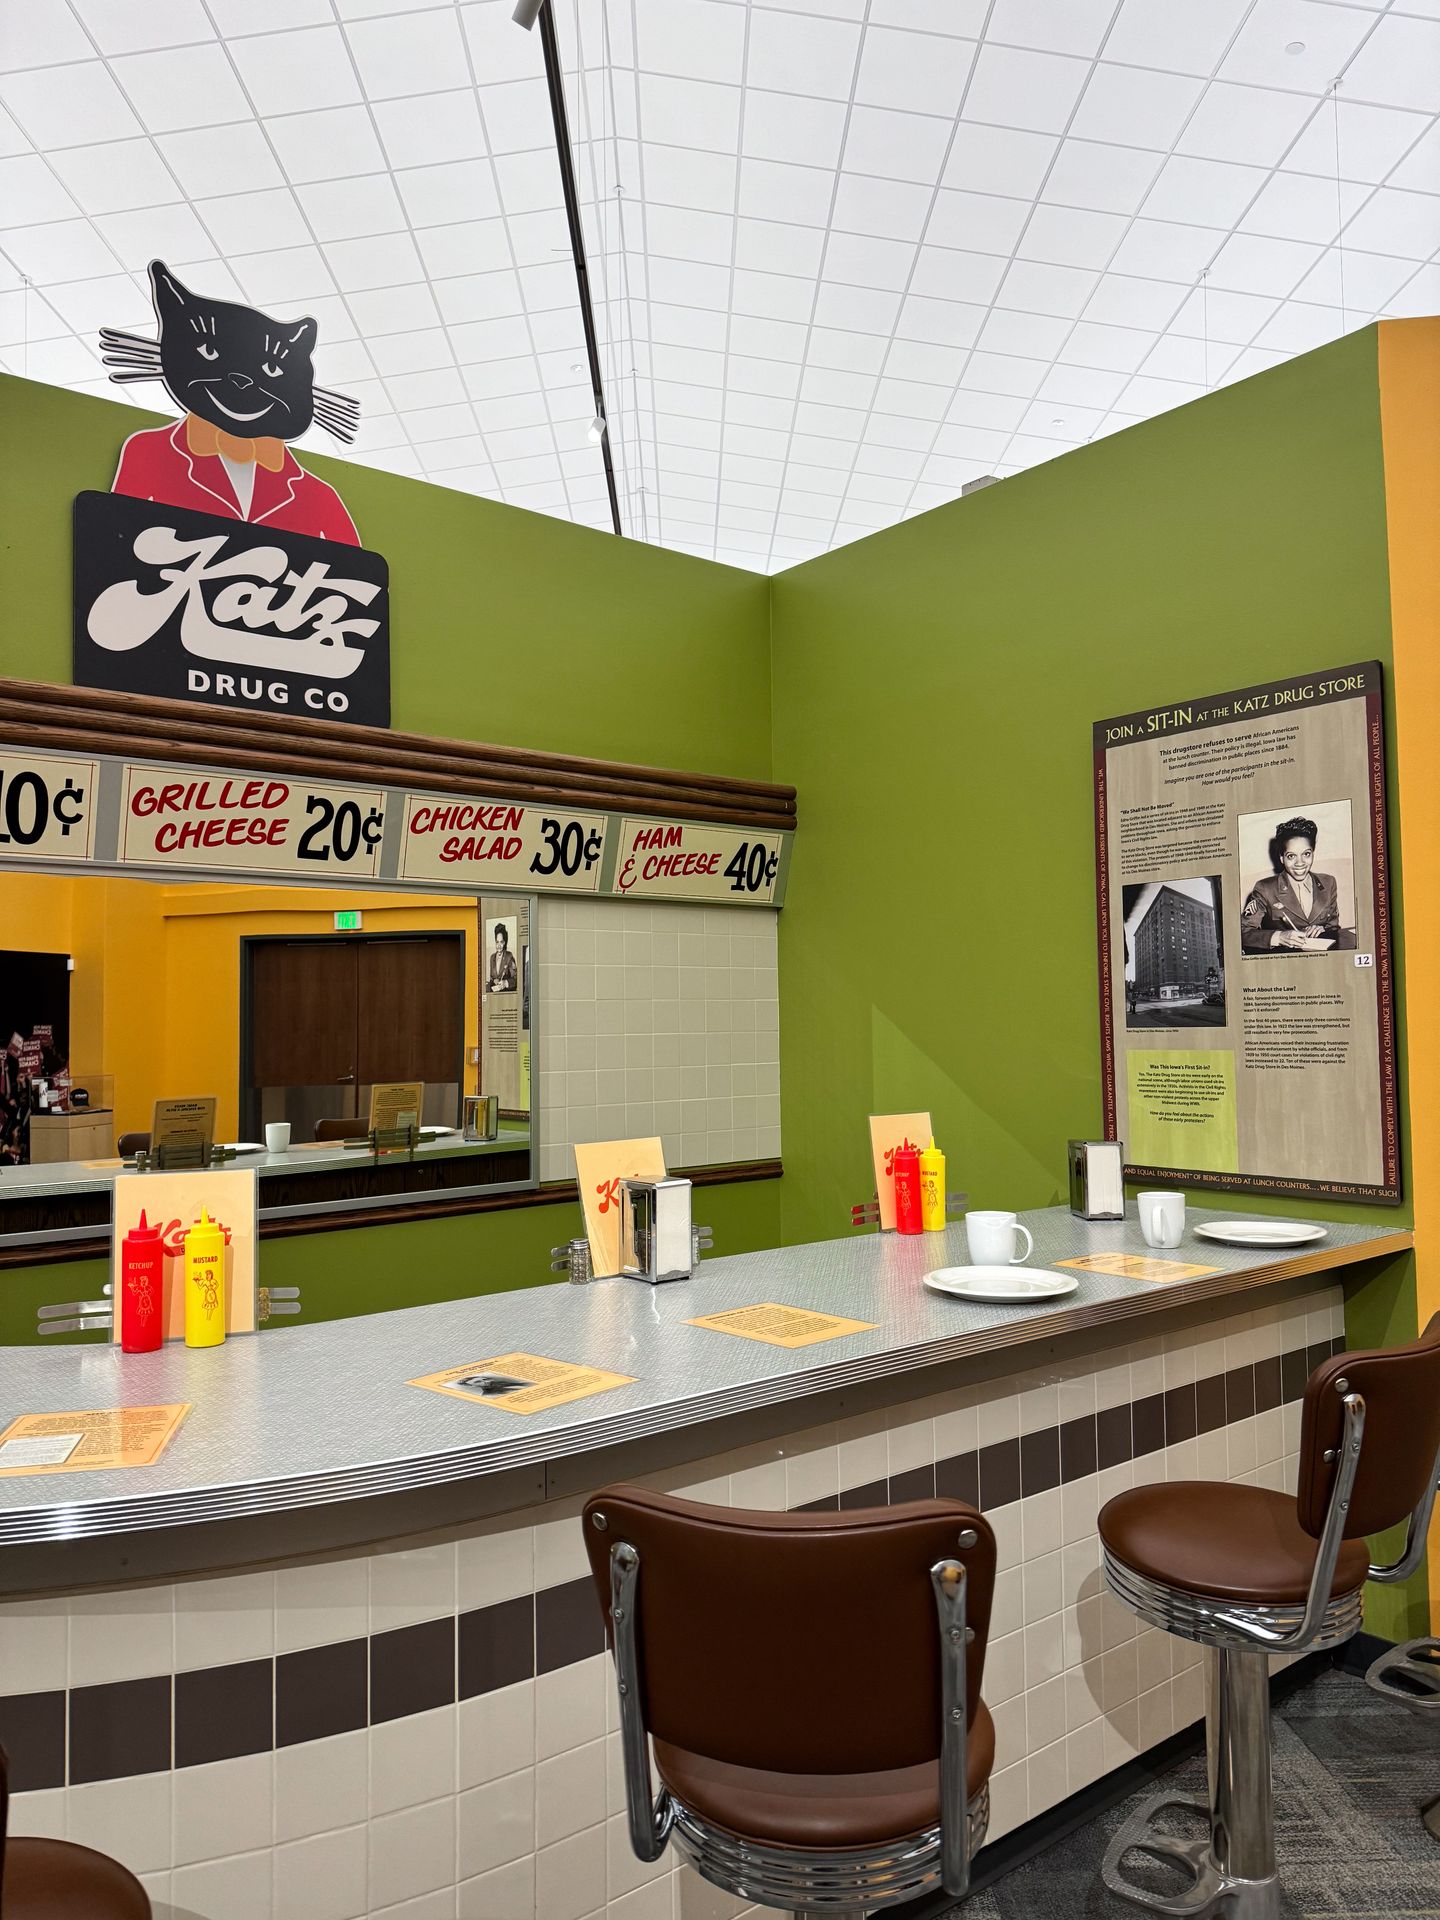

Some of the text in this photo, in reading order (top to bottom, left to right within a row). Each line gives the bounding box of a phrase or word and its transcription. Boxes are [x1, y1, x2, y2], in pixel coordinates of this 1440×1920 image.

[87, 526, 382, 679] Katz
[187, 669, 349, 713] DRUG CO
[1105, 674, 1365, 743] JOIN A SIT-IN AT THE KATZ DRUG STORE
[1172, 743, 1202, 754] drugstore
[1202, 739, 1225, 748] refuses
[1234, 734, 1252, 742] serve
[1271, 725, 1299, 734] Americans
[1190, 750, 1209, 758] counter.
[1224, 745, 1239, 753] policy
[1245, 740, 1262, 748] illegal.
[1168, 762, 1186, 770] banned
[1187, 756, 1221, 767] discrimination
[1227, 752, 1243, 760] public
[1244, 749, 1260, 757] places
[1373, 761, 1380, 771] OF
[1163, 776, 1185, 784] Imagine
[1230, 763, 1263, 774] participants
[1214, 775, 1231, 784] would
[1241, 771, 1255, 779] feel?
[131, 781, 289, 817] GRILLED
[296, 795, 384, 862] 20¢
[410, 805, 525, 835] CHICKEN
[1375, 812, 1384, 853] ENDANGERS
[154, 818, 289, 853] CHEESE
[529, 817, 603, 876] 30¢
[632, 826, 683, 852] HAM
[439, 836, 522, 863] SALAD
[618, 852, 722, 894] & CHEESE
[724, 842, 779, 892] 40¢
[1377, 872, 1385, 888] PLAY
[1378, 907, 1386, 917] OF
[1379, 918, 1387, 956] TRADITION
[1357, 956, 1370, 965] 12
[1381, 979, 1389, 992] THE
[1382, 994, 1389, 1005] TO
[1382, 1006, 1391, 1047] CHALLENGE
[1386, 1116, 1394, 1144] COMPLY
[1387, 1145, 1395, 1155] TO
[1136, 1168, 1155, 1176] EQUAL
[1252, 1178, 1274, 1186] LUNCH
[1331, 1185, 1356, 1194] BELIEVE
[1357, 1187, 1376, 1195] THAT
[1378, 1189, 1397, 1197] SUCH
[1388, 1158, 1396, 1185] FAILURE
[128, 1261, 154, 1270] KETCHUP
[192, 1255, 219, 1264] MUSTARD
